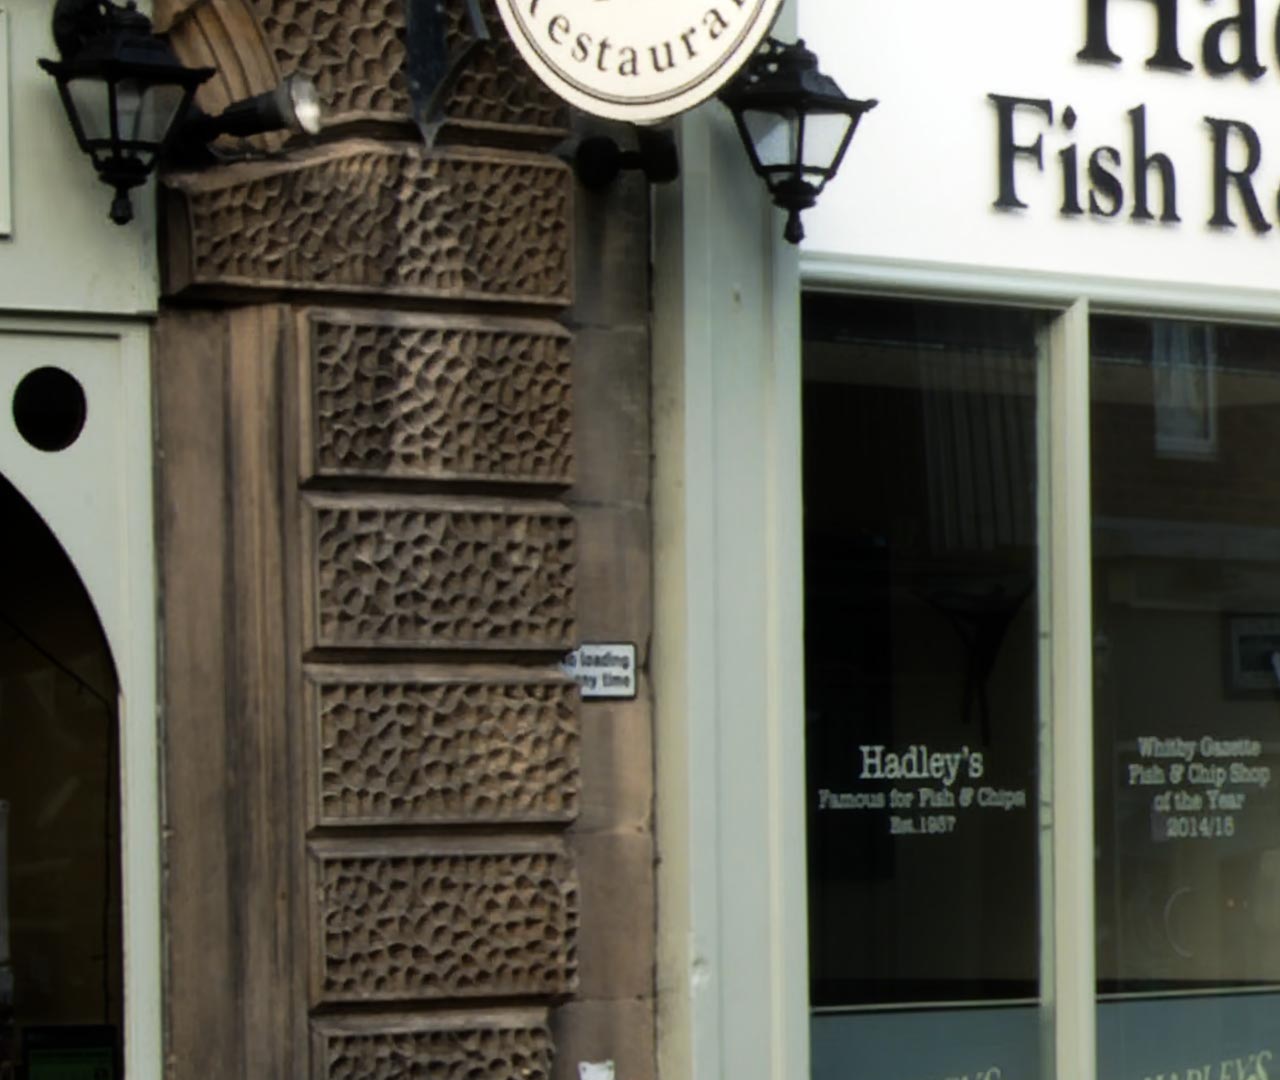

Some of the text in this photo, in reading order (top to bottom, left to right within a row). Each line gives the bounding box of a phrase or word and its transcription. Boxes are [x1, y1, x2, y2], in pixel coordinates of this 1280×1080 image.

[988, 93, 1181, 223] Fish
[581, 651, 630, 670] loading
[603, 673, 630, 688] time
[1138, 735, 1262, 762] Whitby Gazette
[859, 745, 984, 785] Hadley's
[1128, 764, 1165, 785] Fish
[1188, 763, 1227, 788] Chip
[1229, 762, 1271, 788] Shop
[818, 789, 885, 809] Famous
[890, 788, 914, 808] for
[919, 787, 955, 808] Fish
[977, 787, 1026, 811] Chips
[1154, 789, 1246, 812] of the Year
